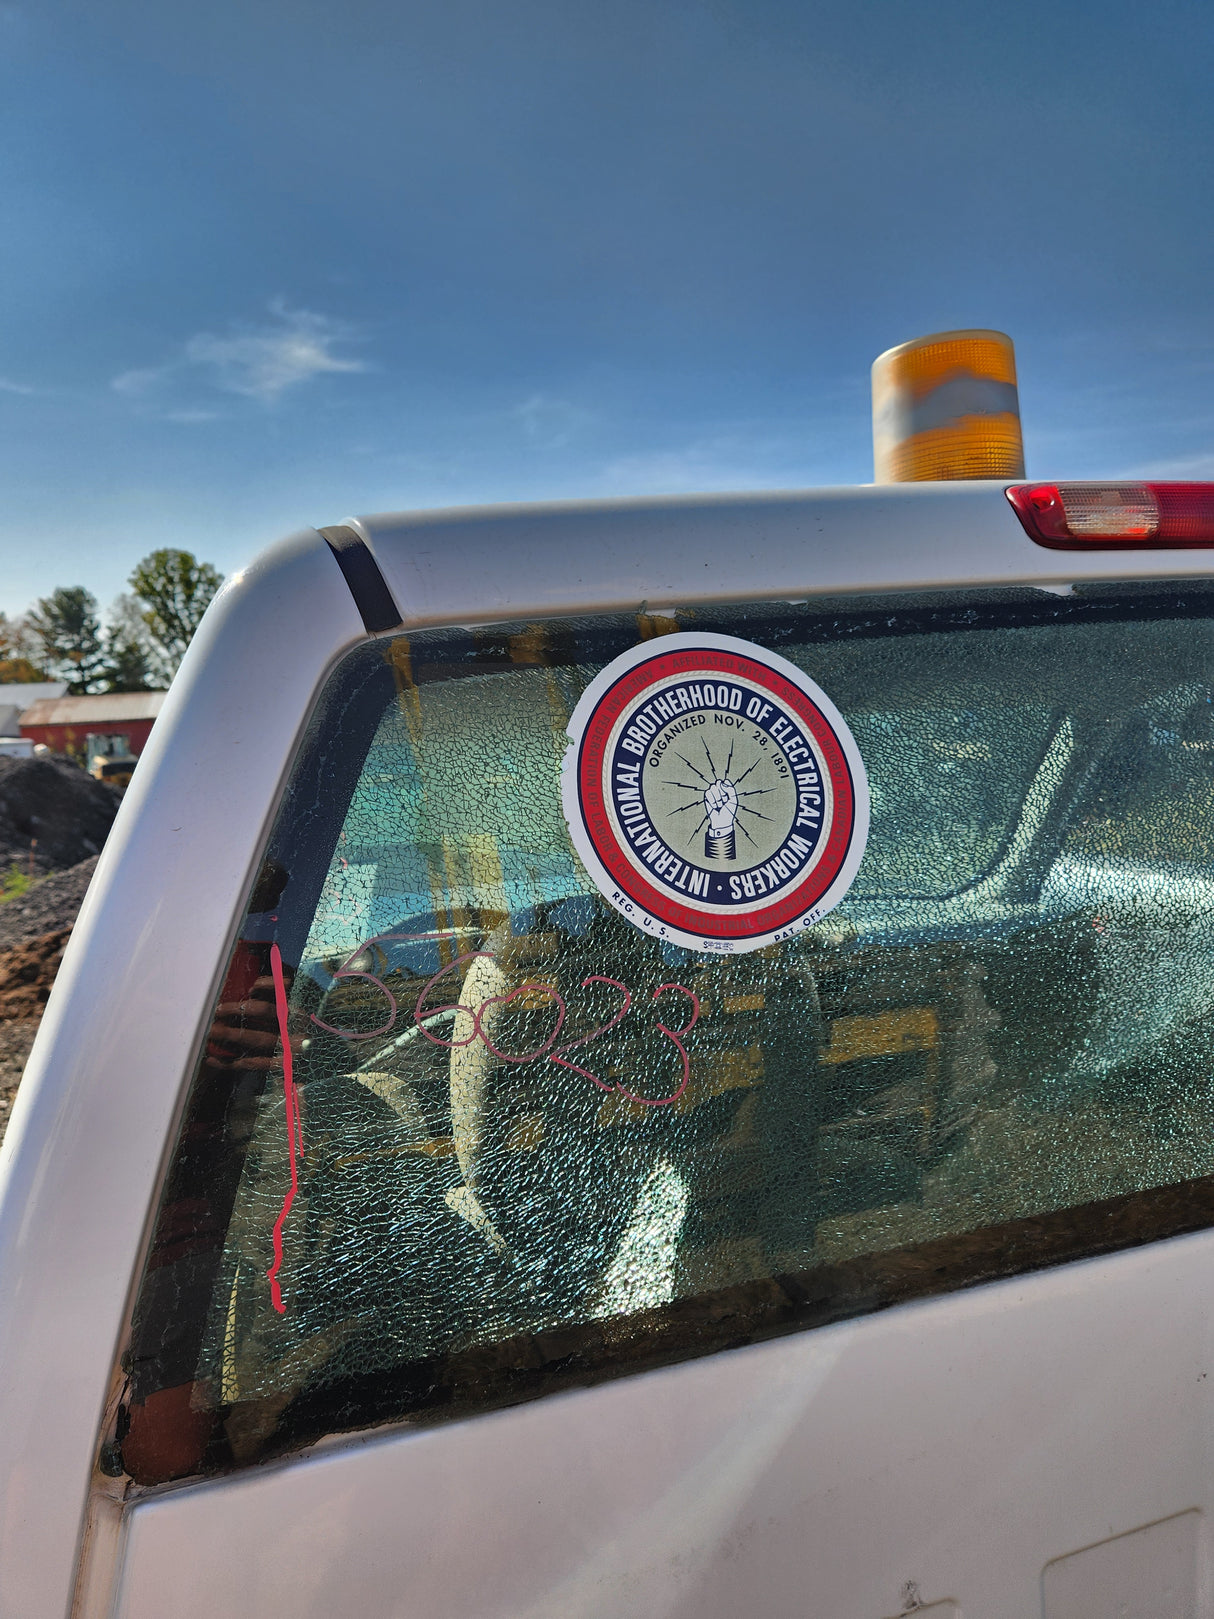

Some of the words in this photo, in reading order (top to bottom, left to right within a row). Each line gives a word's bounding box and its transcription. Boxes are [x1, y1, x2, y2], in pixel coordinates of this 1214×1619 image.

[605, 668, 653, 714] AMERICAN
[672, 655, 734, 669] AFFILIATED
[738, 661, 767, 682] WITH
[621, 684, 742, 757] BROTHERHOOD
[746, 696, 773, 723] OF
[781, 686, 827, 736] CONGRESS
[586, 714, 611, 787] FEDERATION
[649, 714, 706, 768] ORGANIZED
[714, 714, 745, 732] NOV.
[752, 730, 768, 751] 28,
[771, 752, 789, 779] 1891
[823, 739, 845, 784] LABOUR
[769, 716, 822, 829] ELECTRICAL
[588, 793, 599, 808] OF
[831, 790, 847, 857] CANADIAN
[591, 813, 614, 852] LABOR
[616, 762, 711, 898] INTERNATIONAL
[616, 863, 666, 911] CONGRESS
[729, 833, 813, 900] WORKERS
[611, 891, 635, 917] REG.
[773, 927, 800, 942] PAT.
[803, 907, 826, 926] OFF.
[668, 906, 682, 920] OF
[757, 864, 831, 926] ORGANIZATIONS
[685, 913, 754, 931] INDUSTRIAL
[310, 932, 700, 1106] 56023
